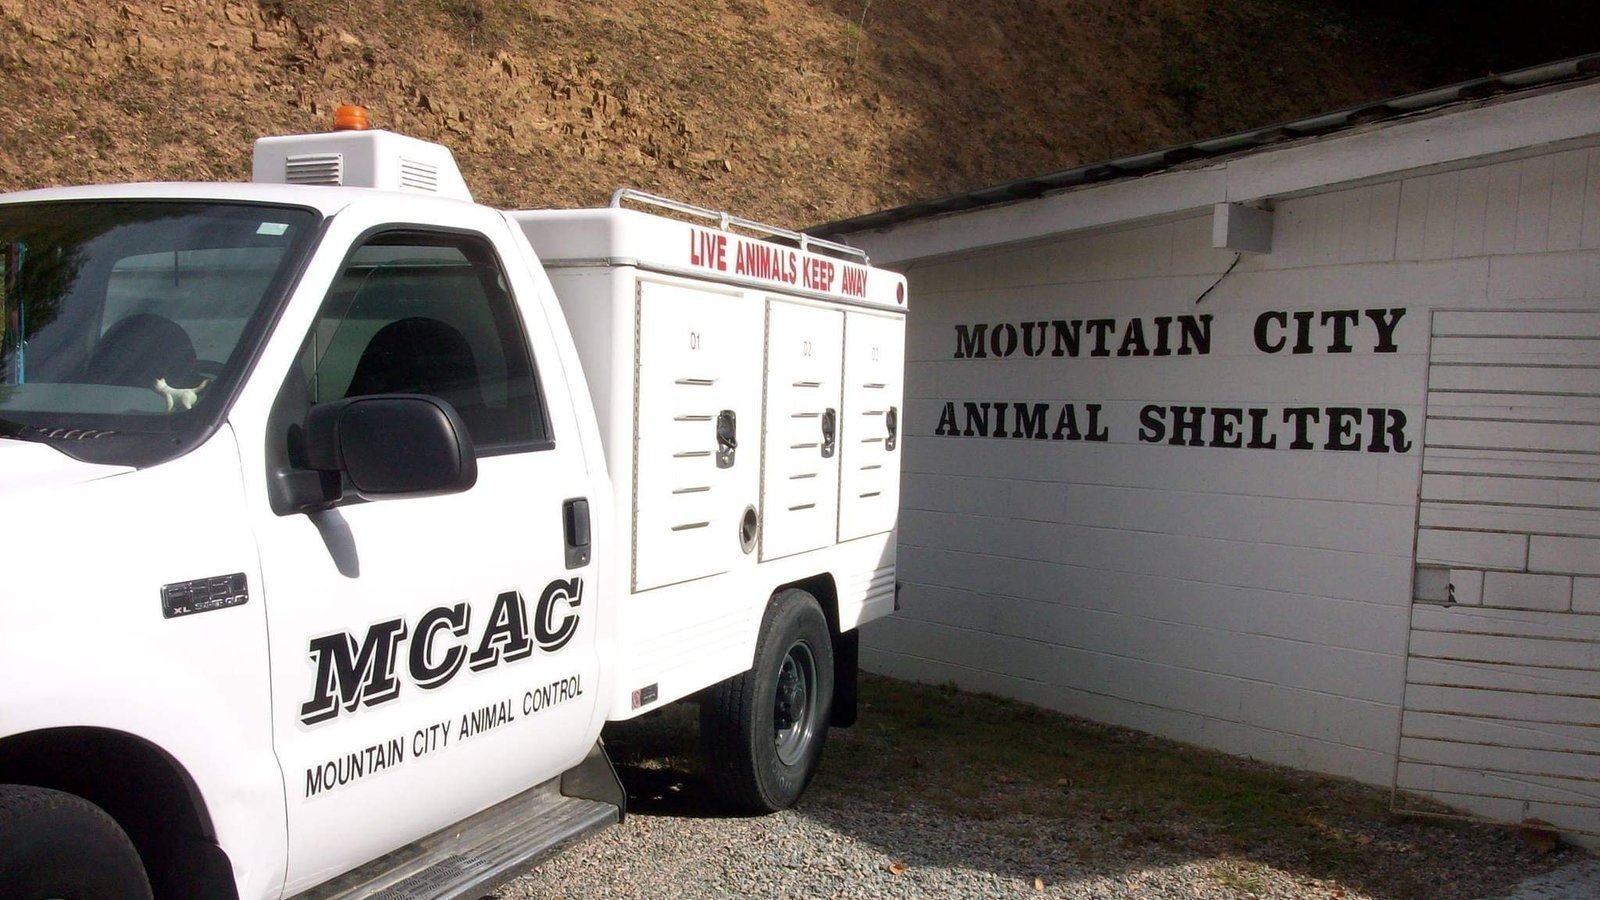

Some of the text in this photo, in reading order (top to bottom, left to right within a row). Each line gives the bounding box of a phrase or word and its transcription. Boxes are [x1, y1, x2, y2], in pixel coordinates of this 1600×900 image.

[690, 228, 868, 298] LIVE ANIMALS KEEP AWAY
[953, 307, 1407, 358] MOUNTAIN CITY
[935, 401, 1412, 454] ANIMAL SHELTER
[173, 606, 191, 615] XL
[300, 576, 584, 726] MCAC
[305, 674, 583, 798] MOUNTAIN CITY ANIMAL CONTROL
